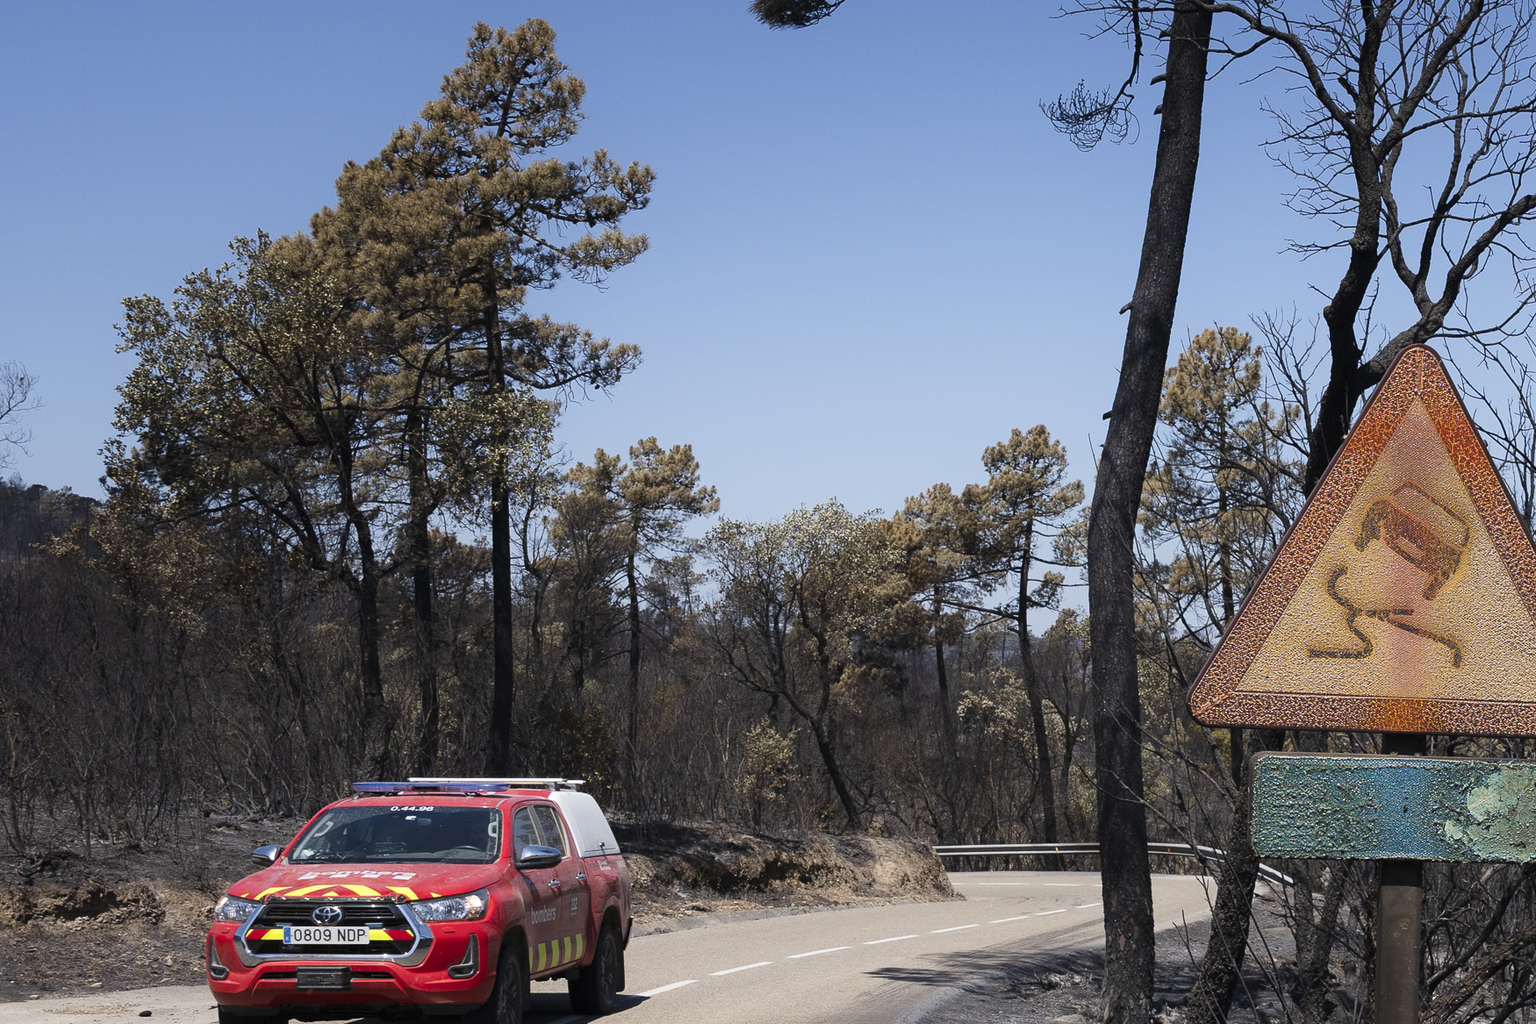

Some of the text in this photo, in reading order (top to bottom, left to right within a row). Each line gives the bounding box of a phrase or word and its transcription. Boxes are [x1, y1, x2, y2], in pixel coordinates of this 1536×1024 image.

[531, 904, 556, 924] bombers
[293, 928, 366, 942] 0809 NDP
